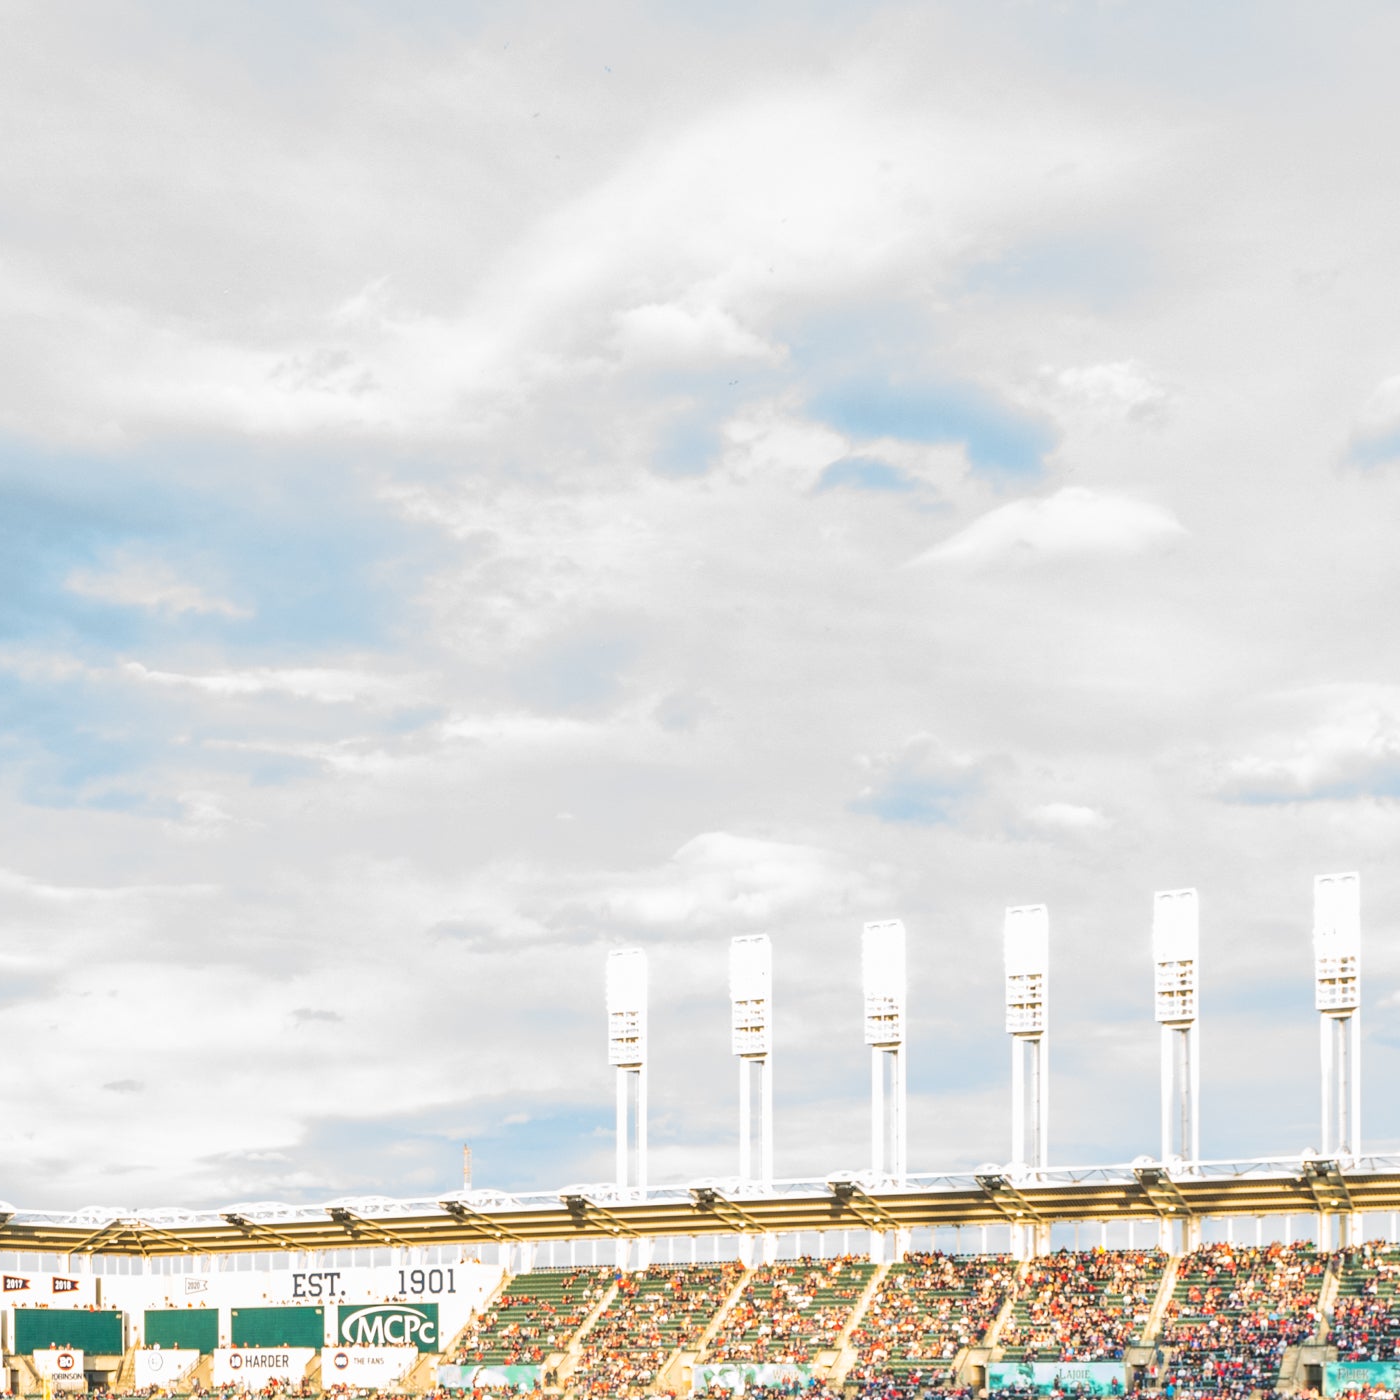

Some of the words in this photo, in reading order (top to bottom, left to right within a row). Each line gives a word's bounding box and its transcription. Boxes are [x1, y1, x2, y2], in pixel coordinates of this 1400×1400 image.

[5, 1279, 23, 1290] 2017
[54, 1280, 71, 1291] 2018
[292, 1272, 346, 1298] EST.
[398, 1268, 456, 1295] 1901
[245, 1354, 290, 1369] HARDER
[367, 1356, 385, 1366] FANS
[1059, 1368, 1091, 1380] LAJOIE
[1336, 1368, 1370, 1381] FLICK
